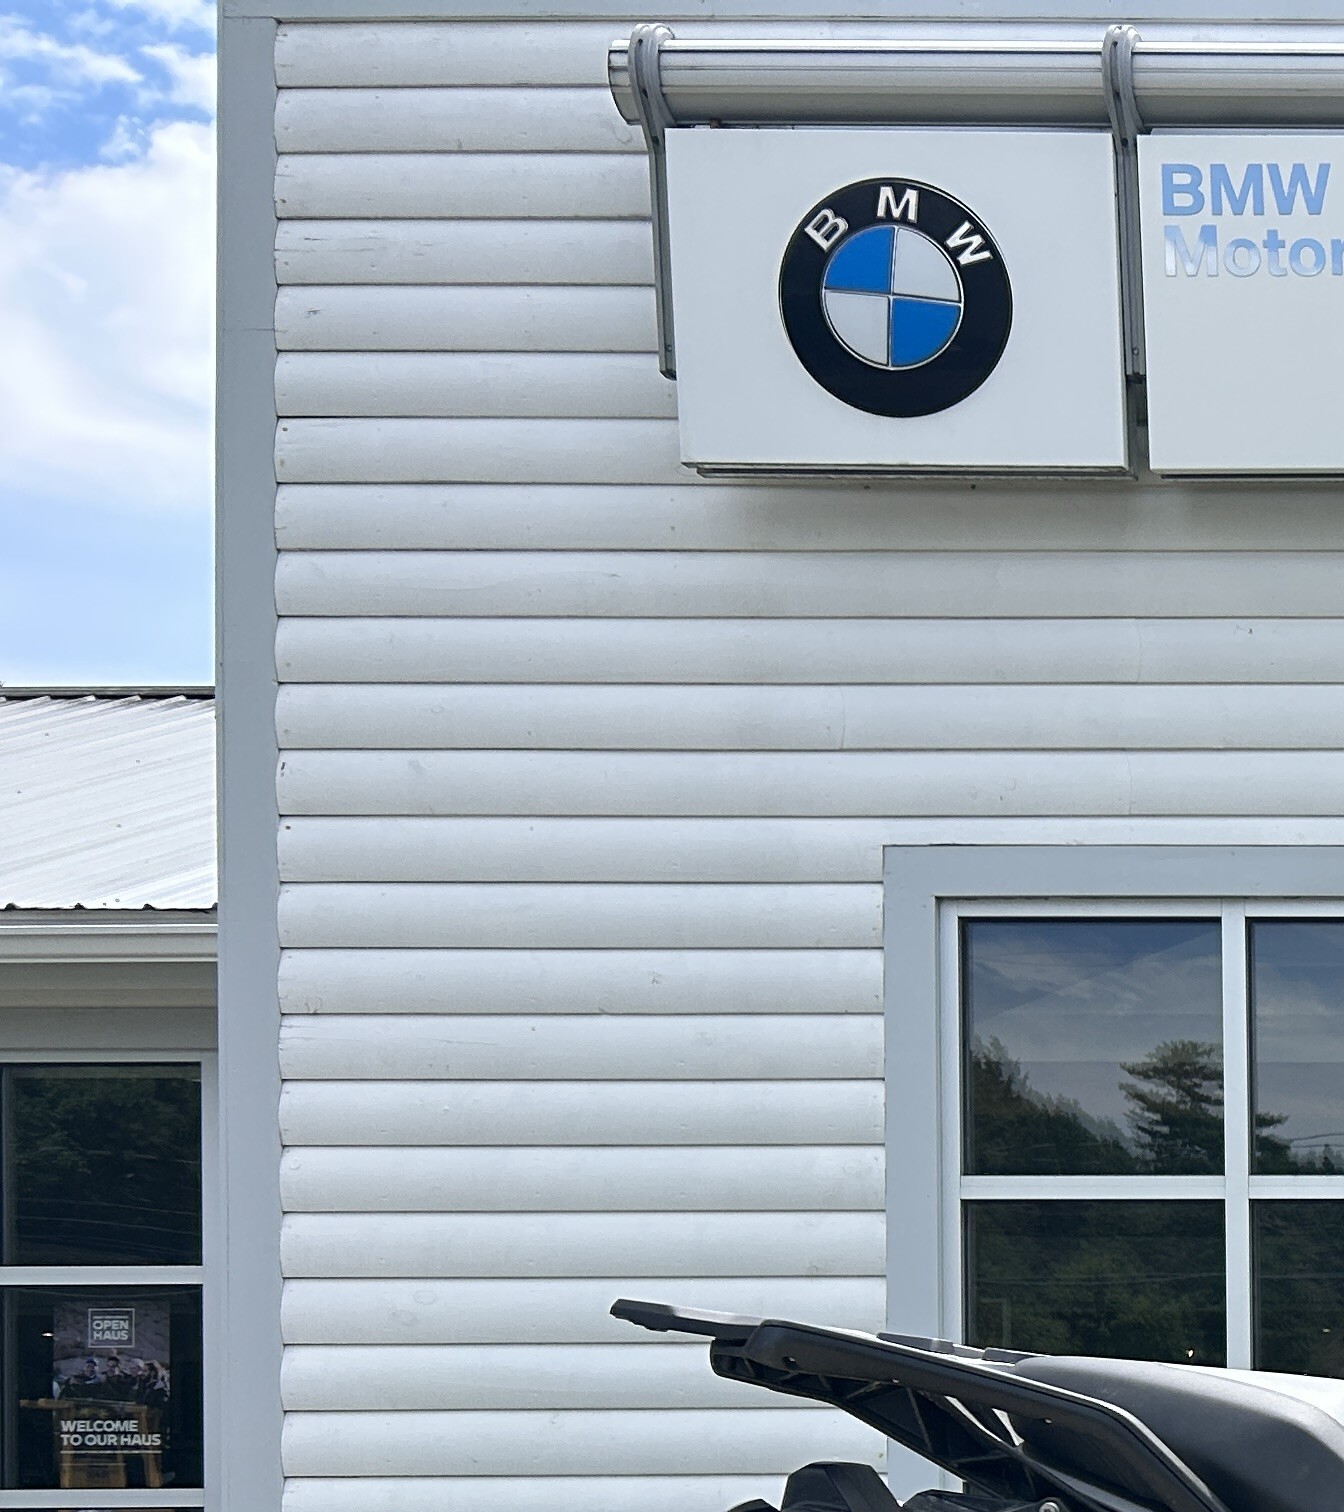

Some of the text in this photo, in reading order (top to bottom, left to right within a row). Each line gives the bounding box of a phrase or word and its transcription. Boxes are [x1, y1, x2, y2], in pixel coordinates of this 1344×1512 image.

[1160, 162, 1331, 217] BMW
[803, 184, 992, 268] BMW
[92, 1319, 130, 1330] OPEN
[92, 1330, 130, 1341] HAUS
[60, 1419, 139, 1433] WELCOME
[60, 1433, 162, 1447] TO OUR HAUS
